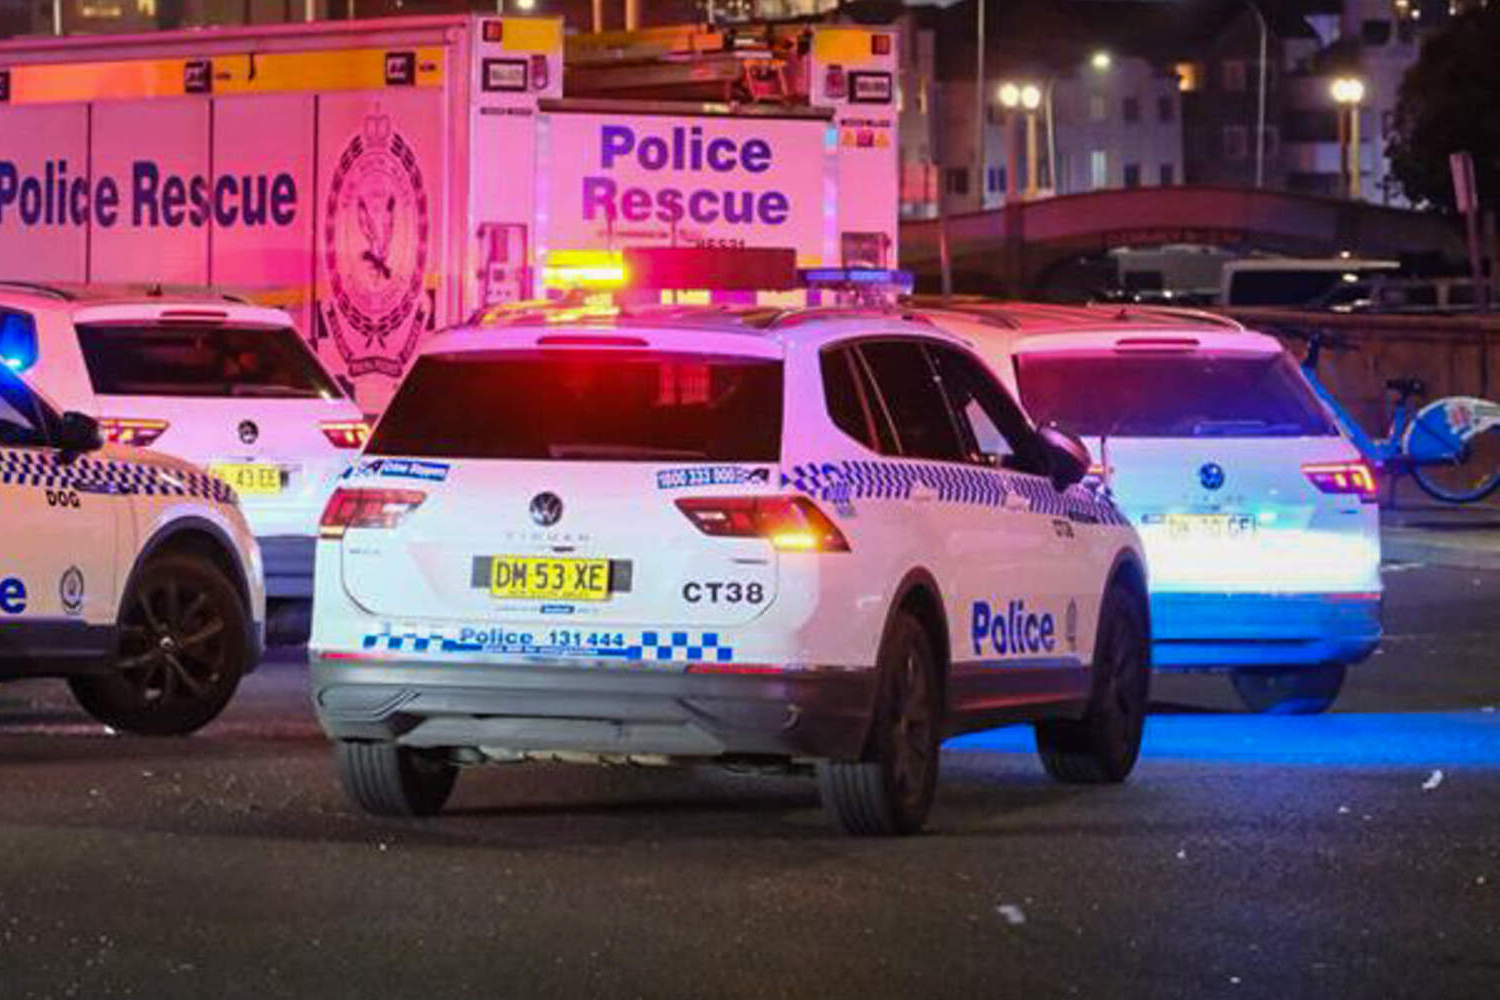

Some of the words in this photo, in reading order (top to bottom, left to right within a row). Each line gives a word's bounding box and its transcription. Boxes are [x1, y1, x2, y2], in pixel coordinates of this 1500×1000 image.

[601, 125, 772, 172] Police
[132, 161, 297, 228] Rescue
[582, 176, 789, 224] Rescue
[495, 560, 528, 588] DM
[535, 562, 565, 590] 53
[574, 564, 605, 592] XE
[682, 581, 764, 604] CT38
[459, 626, 533, 645] Police
[972, 600, 1055, 656] Police
